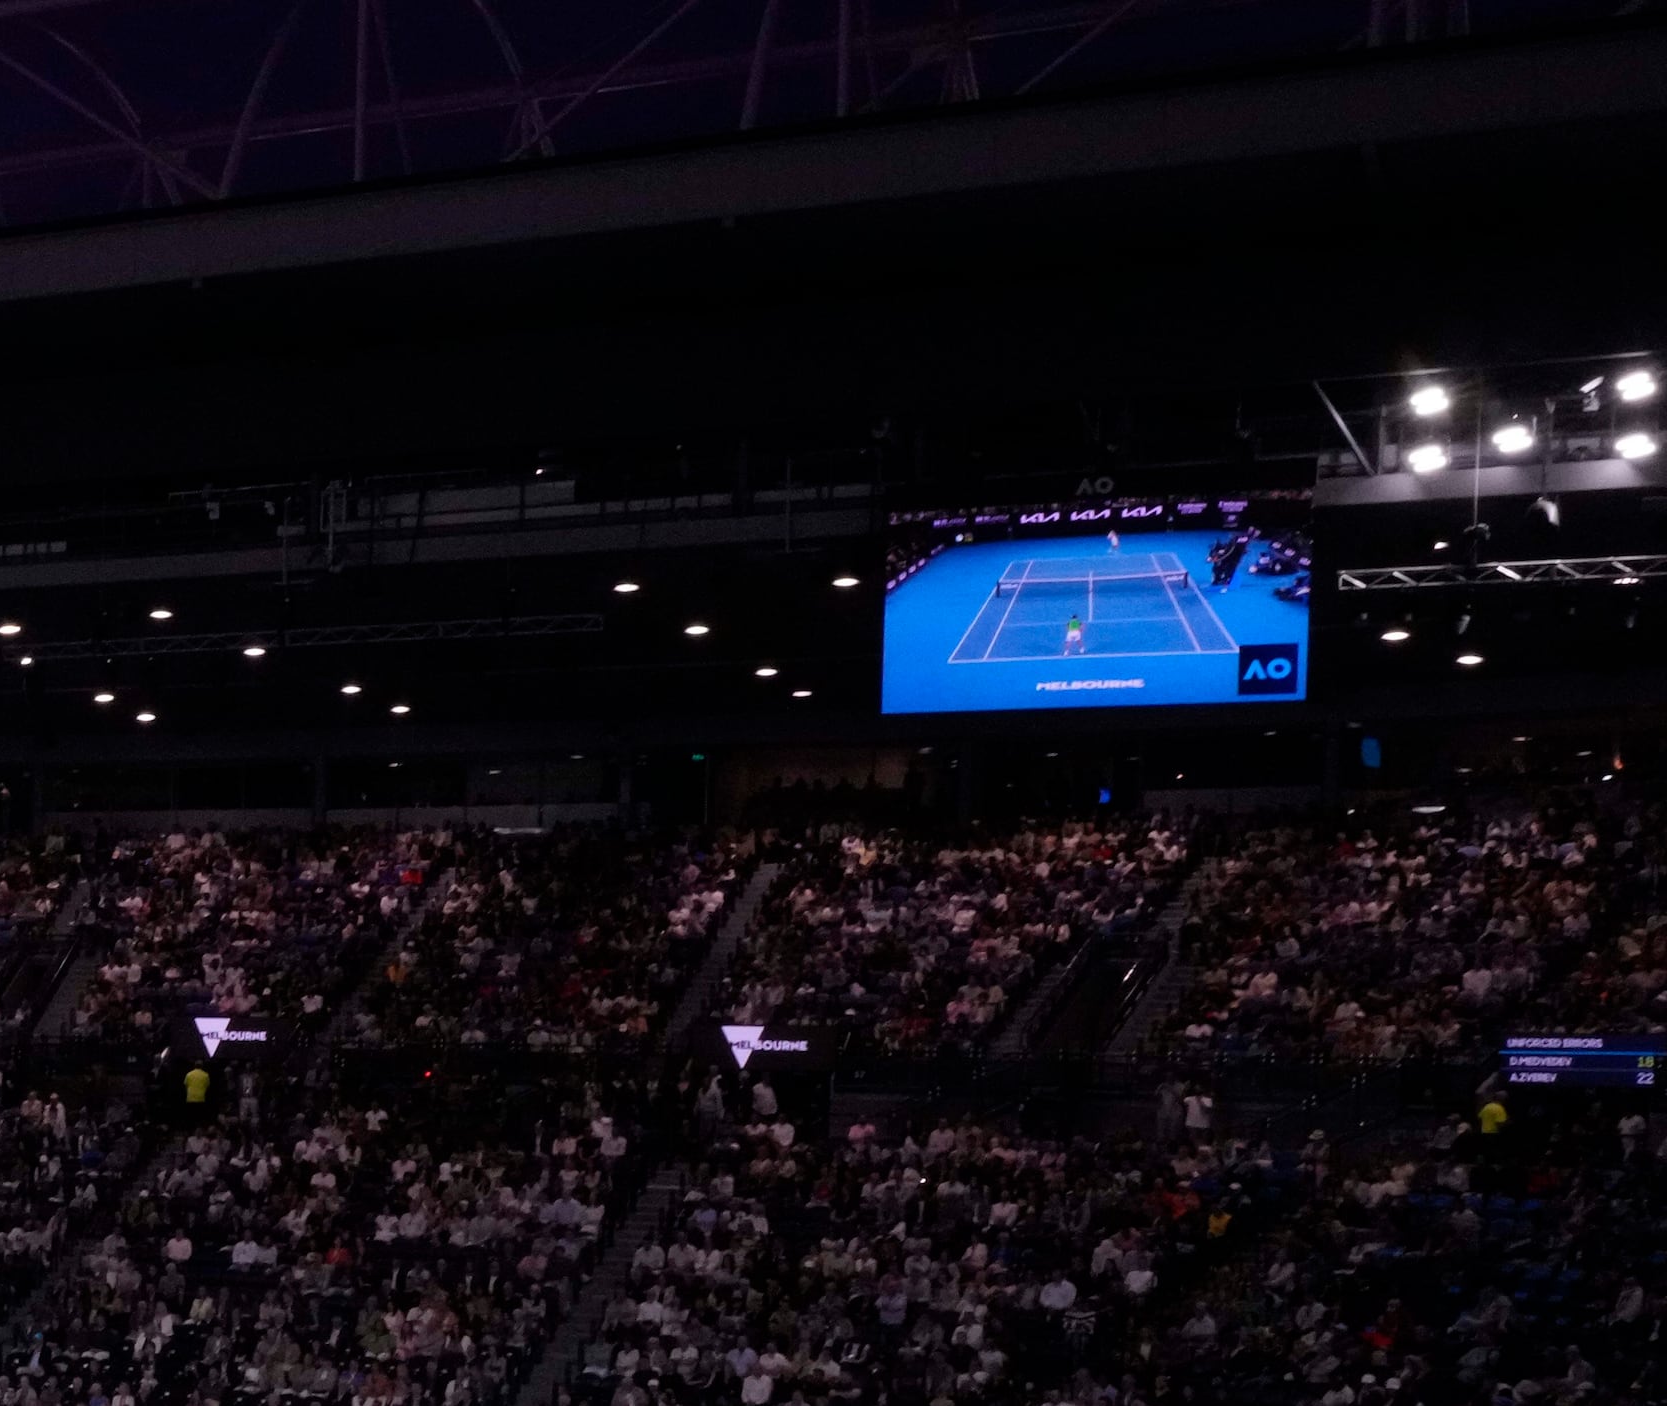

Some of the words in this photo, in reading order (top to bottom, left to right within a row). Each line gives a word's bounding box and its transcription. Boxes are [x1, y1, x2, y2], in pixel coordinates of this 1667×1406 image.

[1076, 477, 1116, 495] AO
[1242, 657, 1292, 681] AO
[1036, 678, 1145, 692] MELBOURNE
[202, 1031, 267, 1042] MELBOURNE
[731, 1040, 808, 1051] MELBOURNE
[1637, 1056, 1655, 1068] 18
[1637, 1072, 1655, 1084] 22
